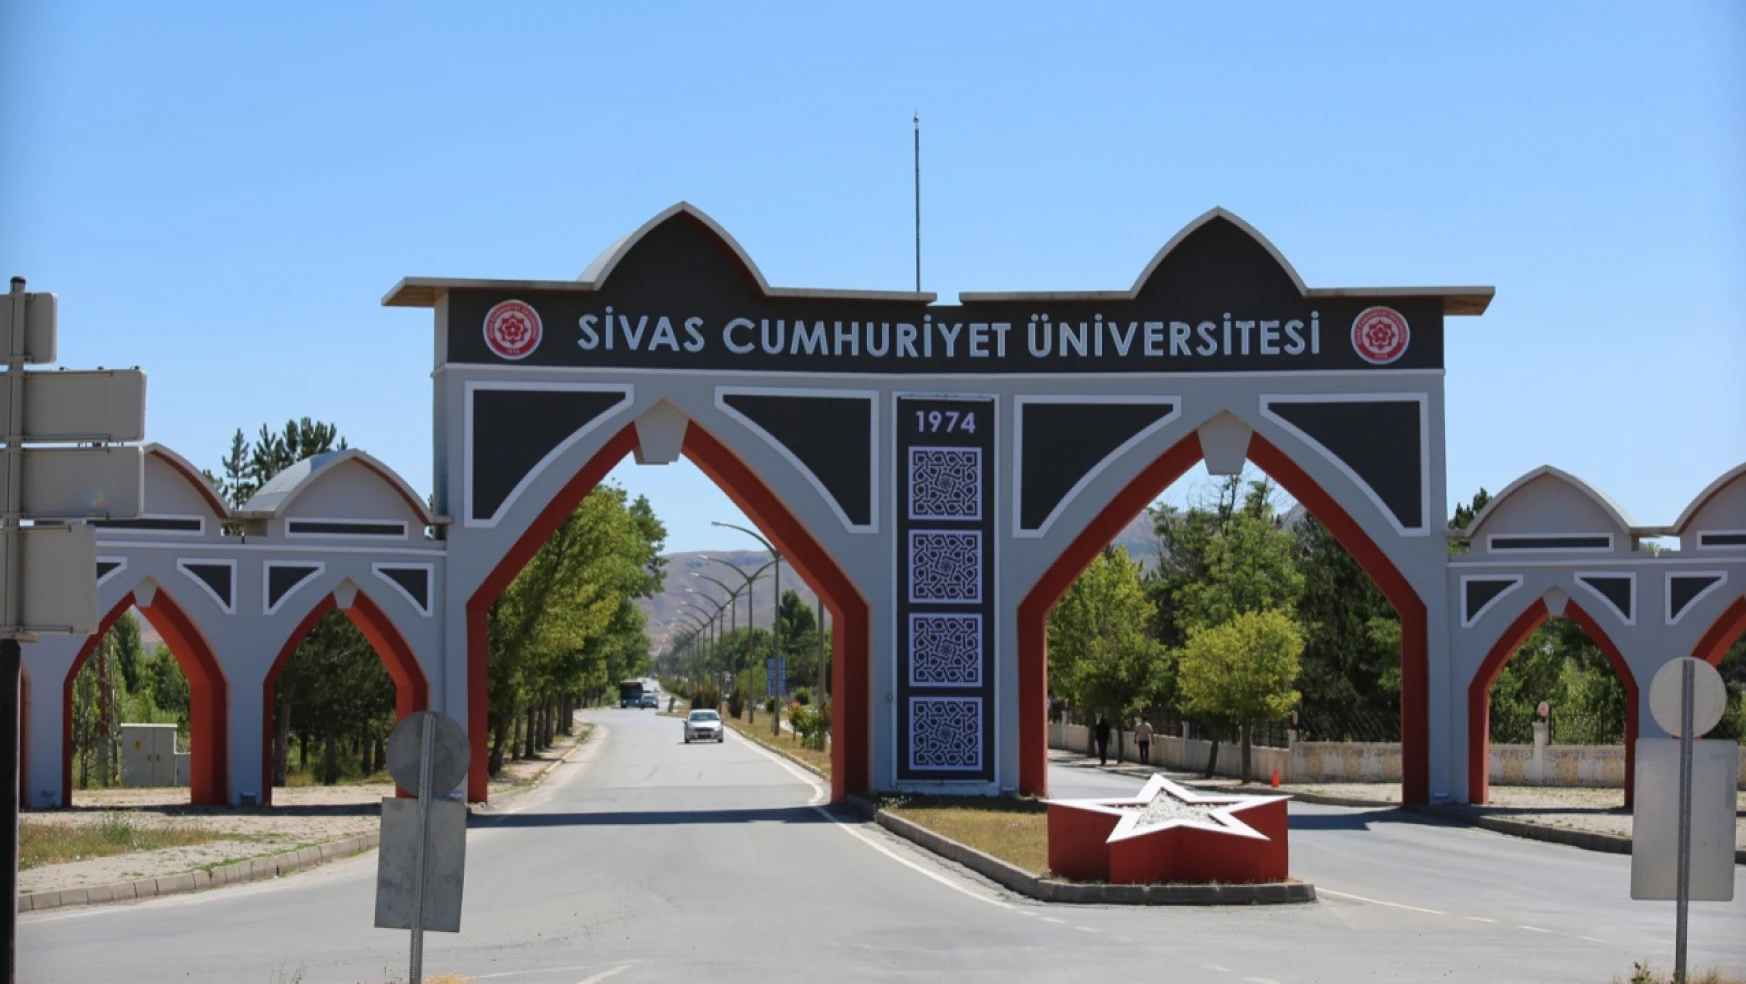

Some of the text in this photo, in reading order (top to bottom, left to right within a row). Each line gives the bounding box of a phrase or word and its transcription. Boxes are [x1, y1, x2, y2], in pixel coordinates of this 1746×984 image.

[577, 305, 705, 352] SİVAS
[722, 314, 1012, 359] CUMHURİYET
[1027, 310, 1321, 358] ÜNİVERSİTESİ
[915, 409, 976, 436] 1974
